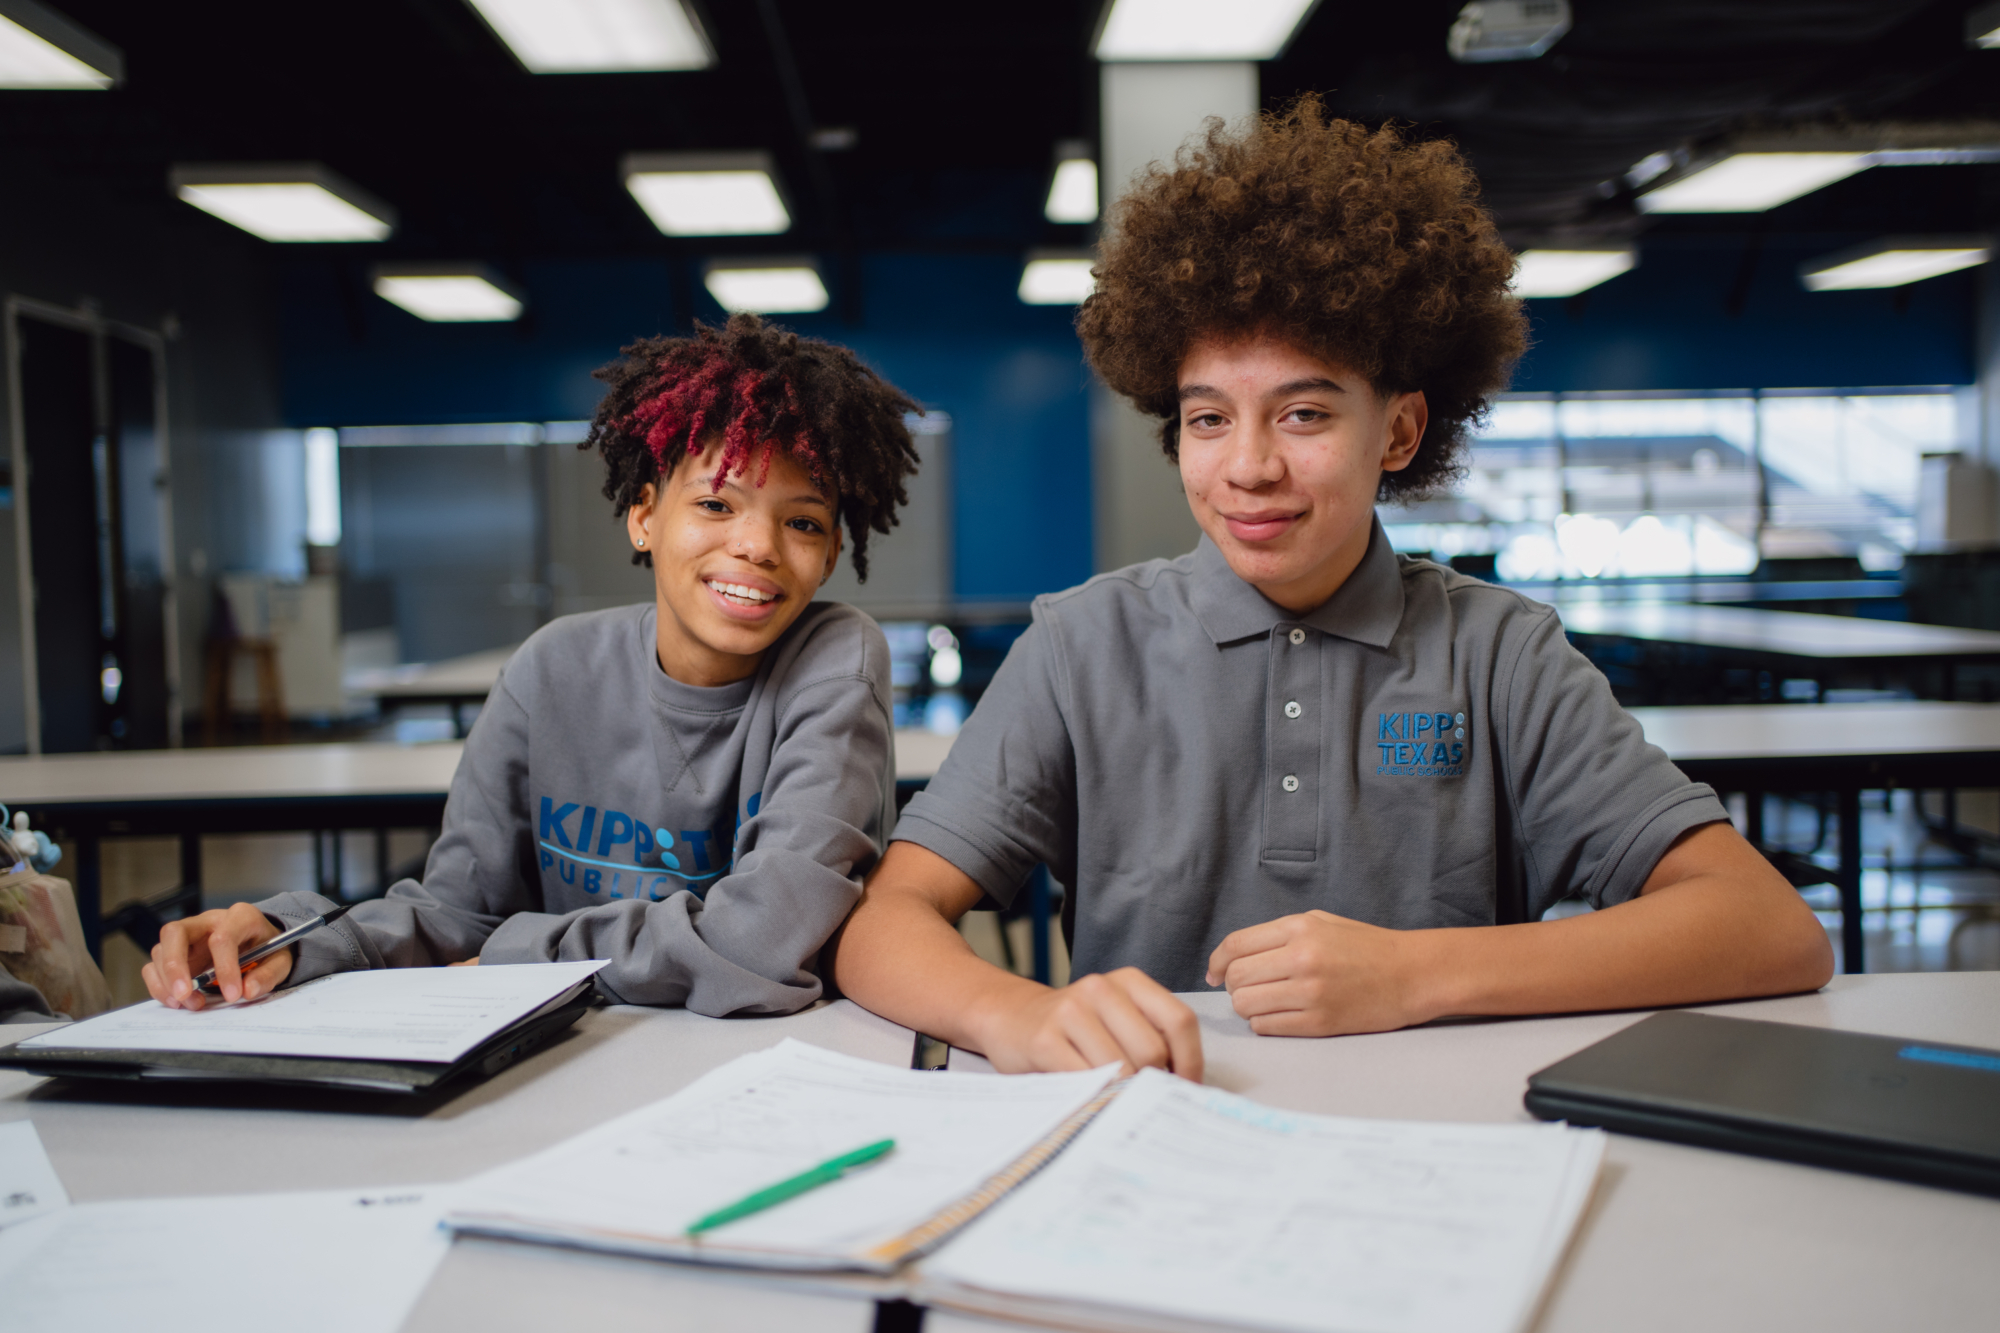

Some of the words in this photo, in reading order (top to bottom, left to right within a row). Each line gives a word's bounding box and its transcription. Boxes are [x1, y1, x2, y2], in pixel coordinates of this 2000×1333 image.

[1377, 742, 1463, 766] TEXAS
[1376, 765, 1415, 776] PUBLIC
[1417, 766, 1463, 777] SCHOOLS
[540, 850, 668, 901] PUBLIC
